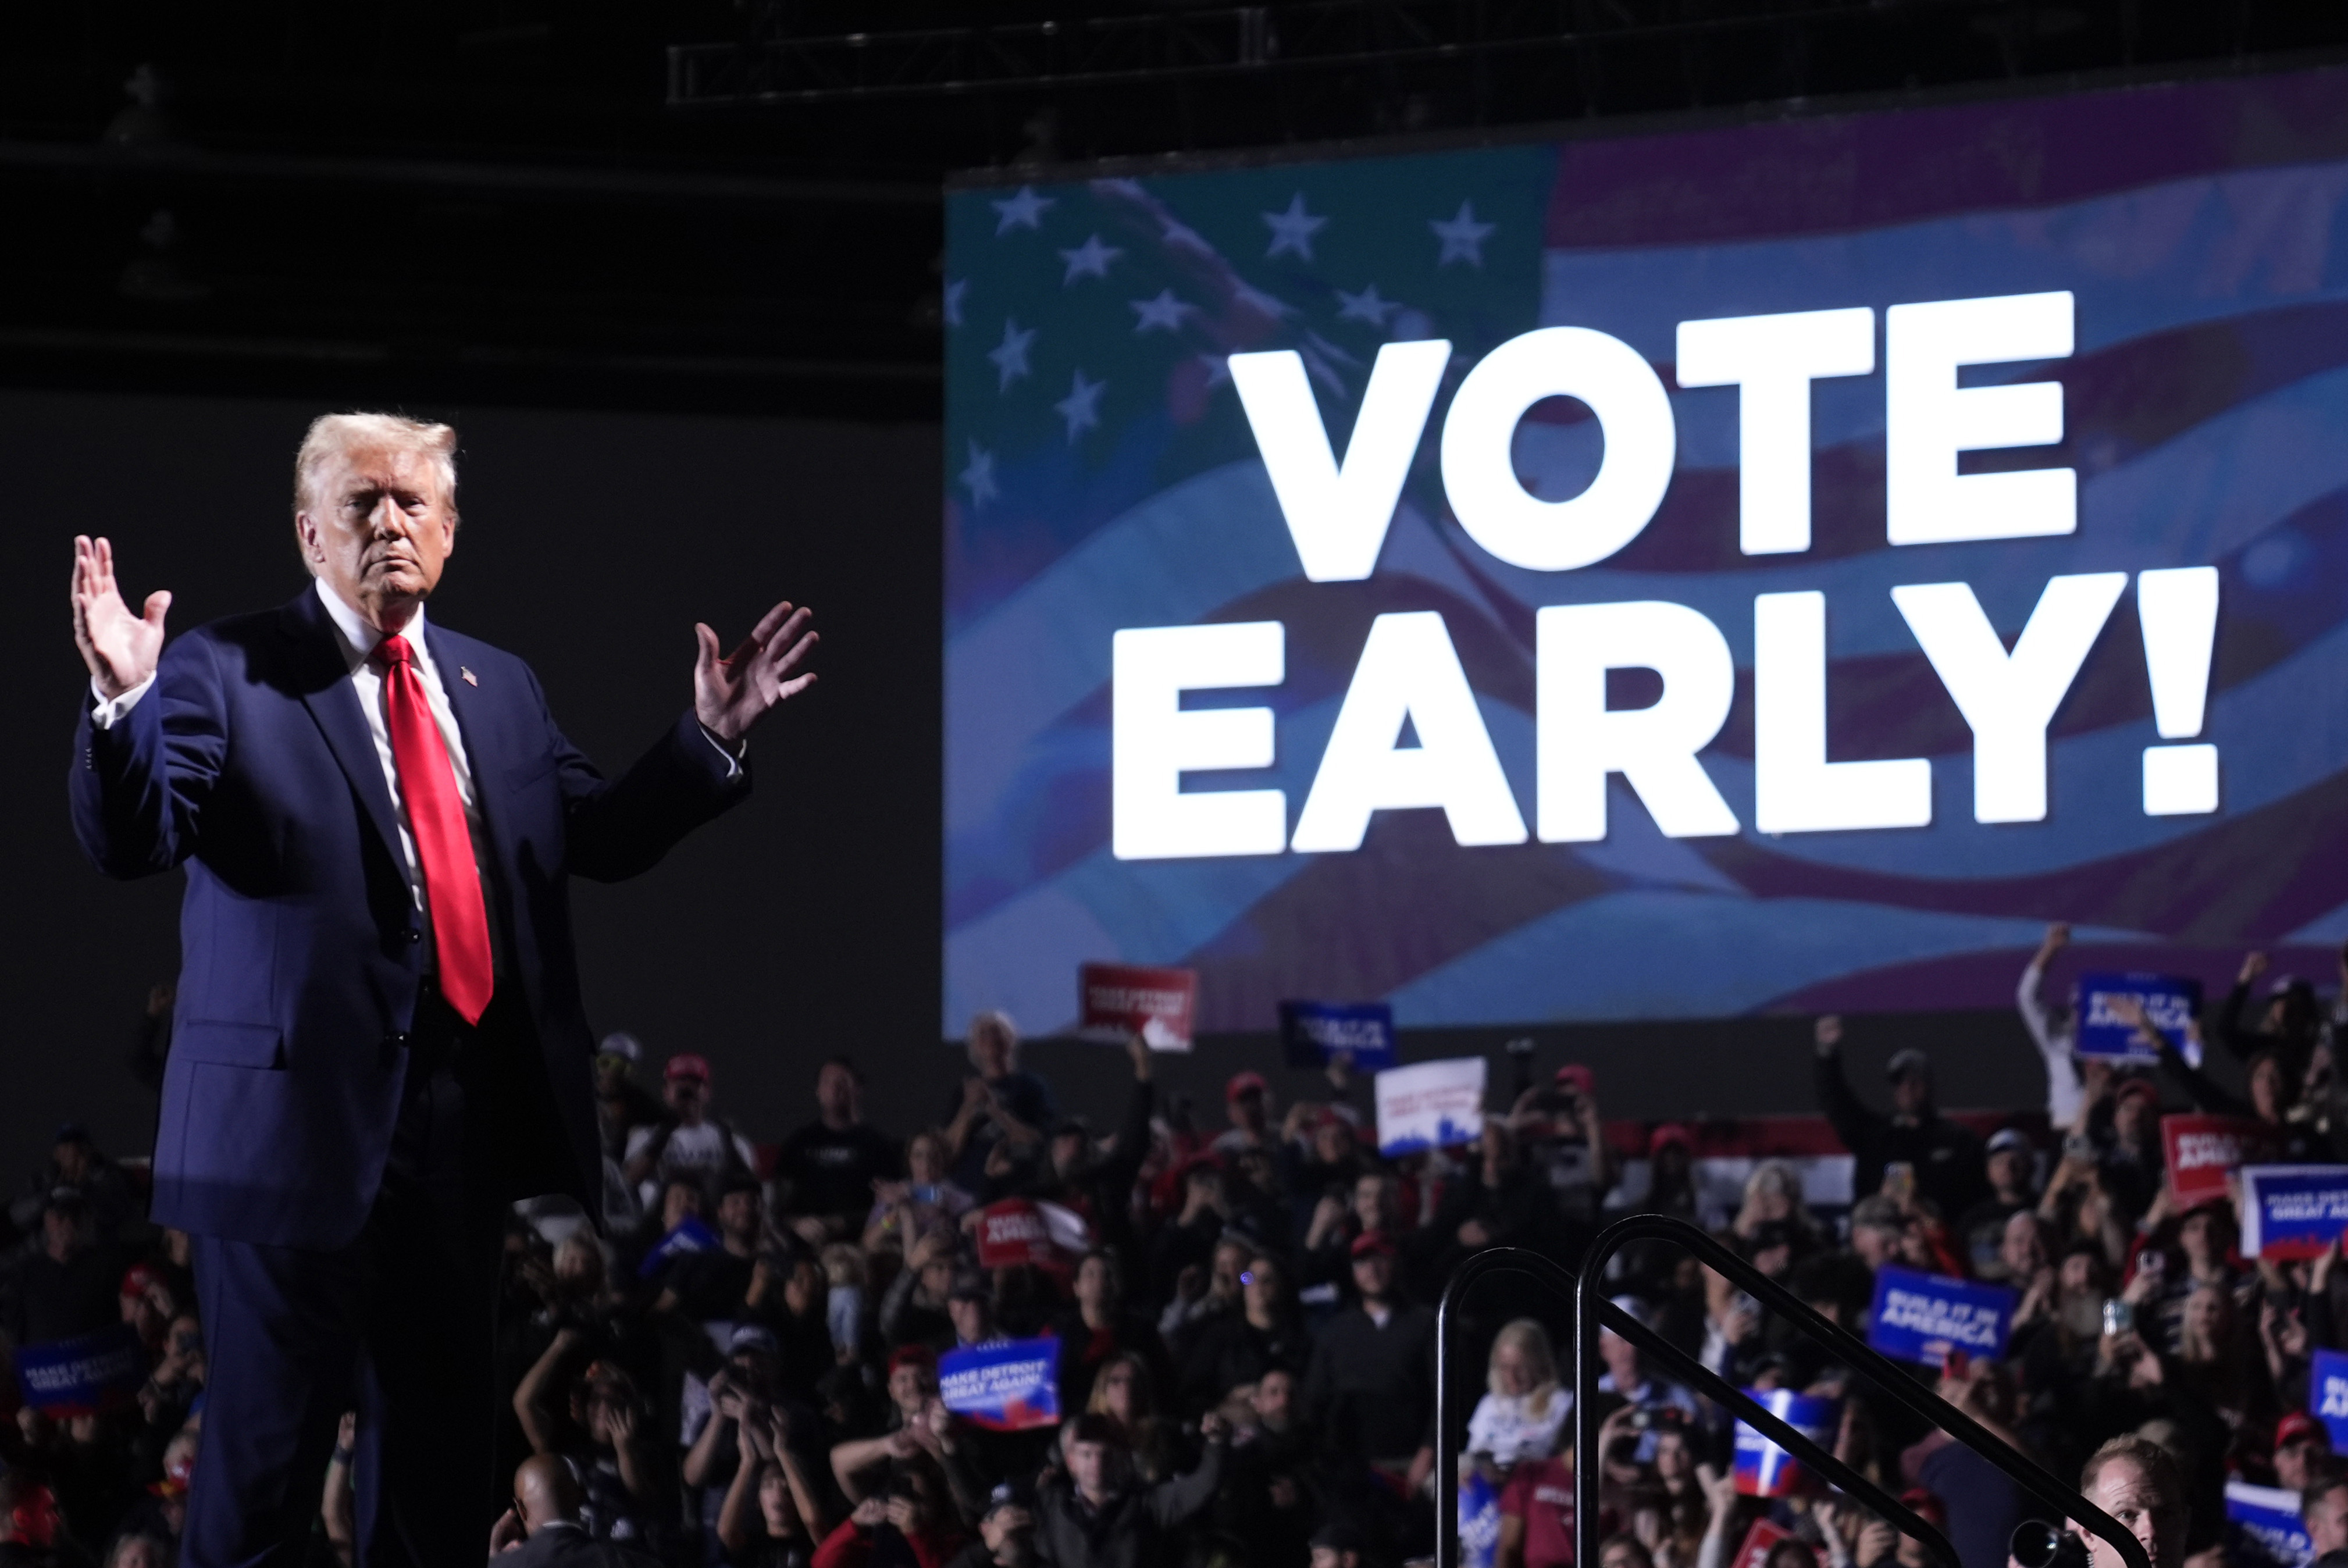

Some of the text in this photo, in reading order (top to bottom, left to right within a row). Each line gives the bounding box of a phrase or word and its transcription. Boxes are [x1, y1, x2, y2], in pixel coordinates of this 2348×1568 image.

[1228, 291, 2076, 582] VOTE
[1113, 566, 2219, 860] EARLY!
[981, 1358, 1046, 1381] DETROIT
[1880, 1306, 1997, 1348] AMERICA
